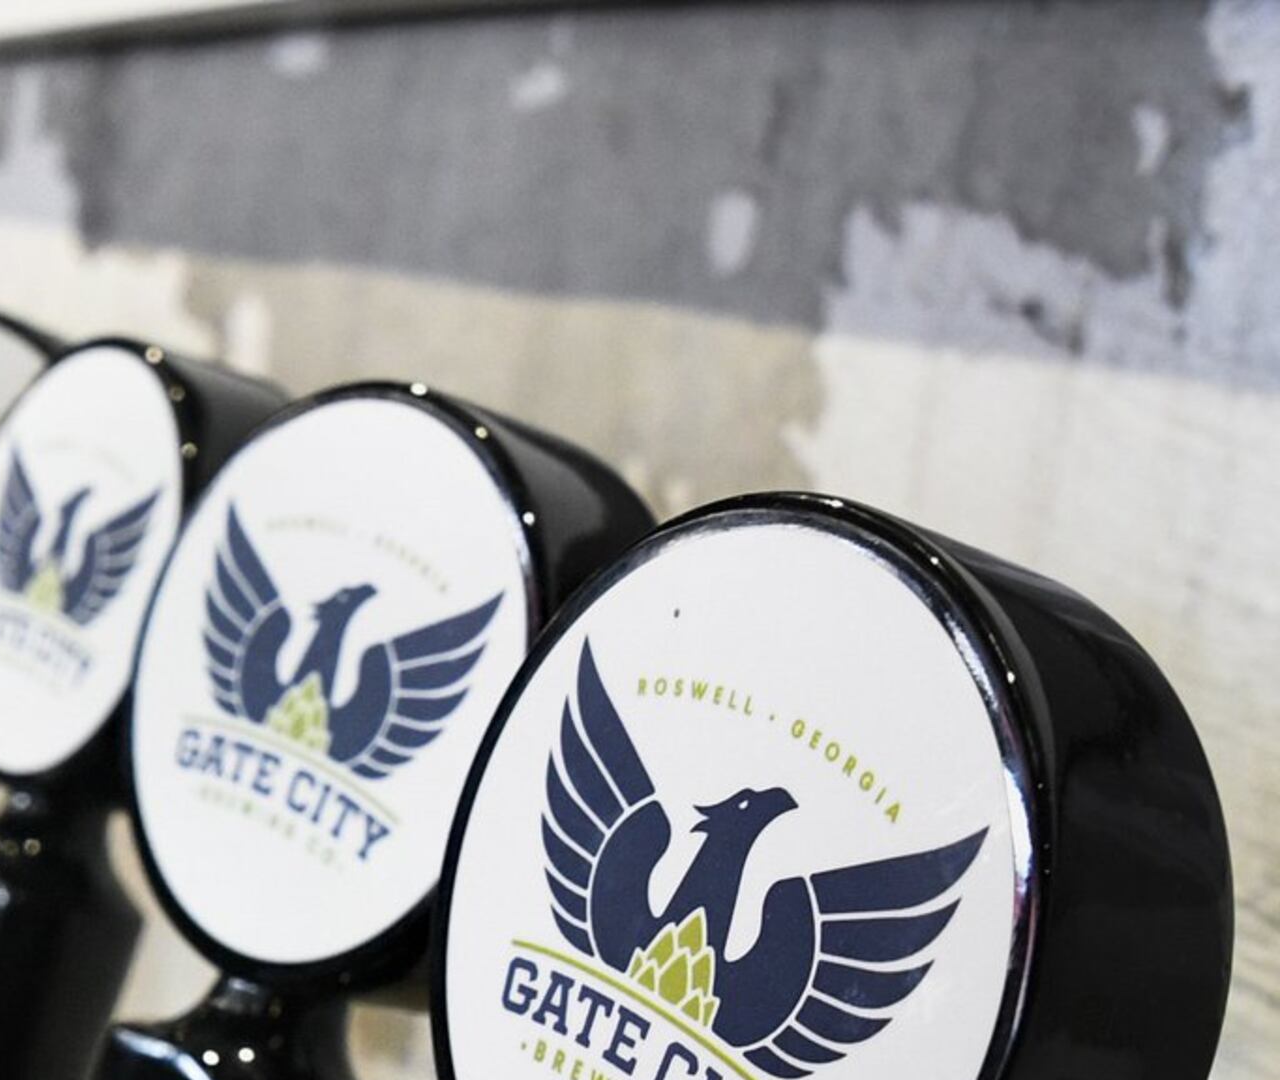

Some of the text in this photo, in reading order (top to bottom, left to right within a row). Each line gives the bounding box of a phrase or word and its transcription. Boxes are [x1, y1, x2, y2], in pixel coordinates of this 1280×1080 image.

[175, 729, 282, 796] GATE
[286, 769, 391, 860] CITY
[637, 678, 902, 823] ROSWELL GEORGIA
[501, 956, 653, 1077] GATE
